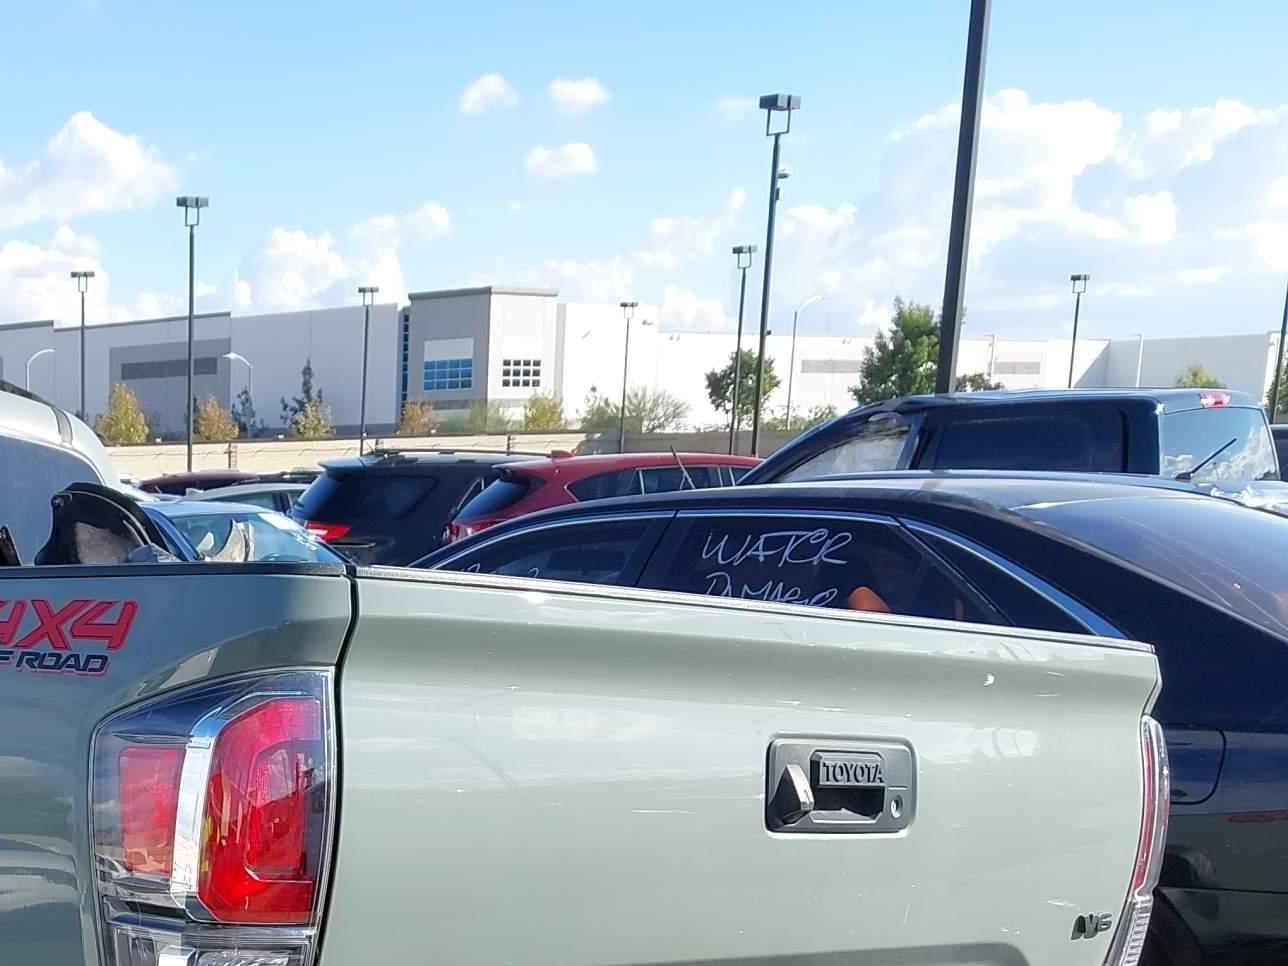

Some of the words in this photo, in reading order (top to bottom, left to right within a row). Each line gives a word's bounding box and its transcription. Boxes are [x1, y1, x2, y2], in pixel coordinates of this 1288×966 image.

[701, 527, 853, 567] WATER
[15, 651, 111, 677] ROAD
[822, 761, 885, 784] TOYOTA
